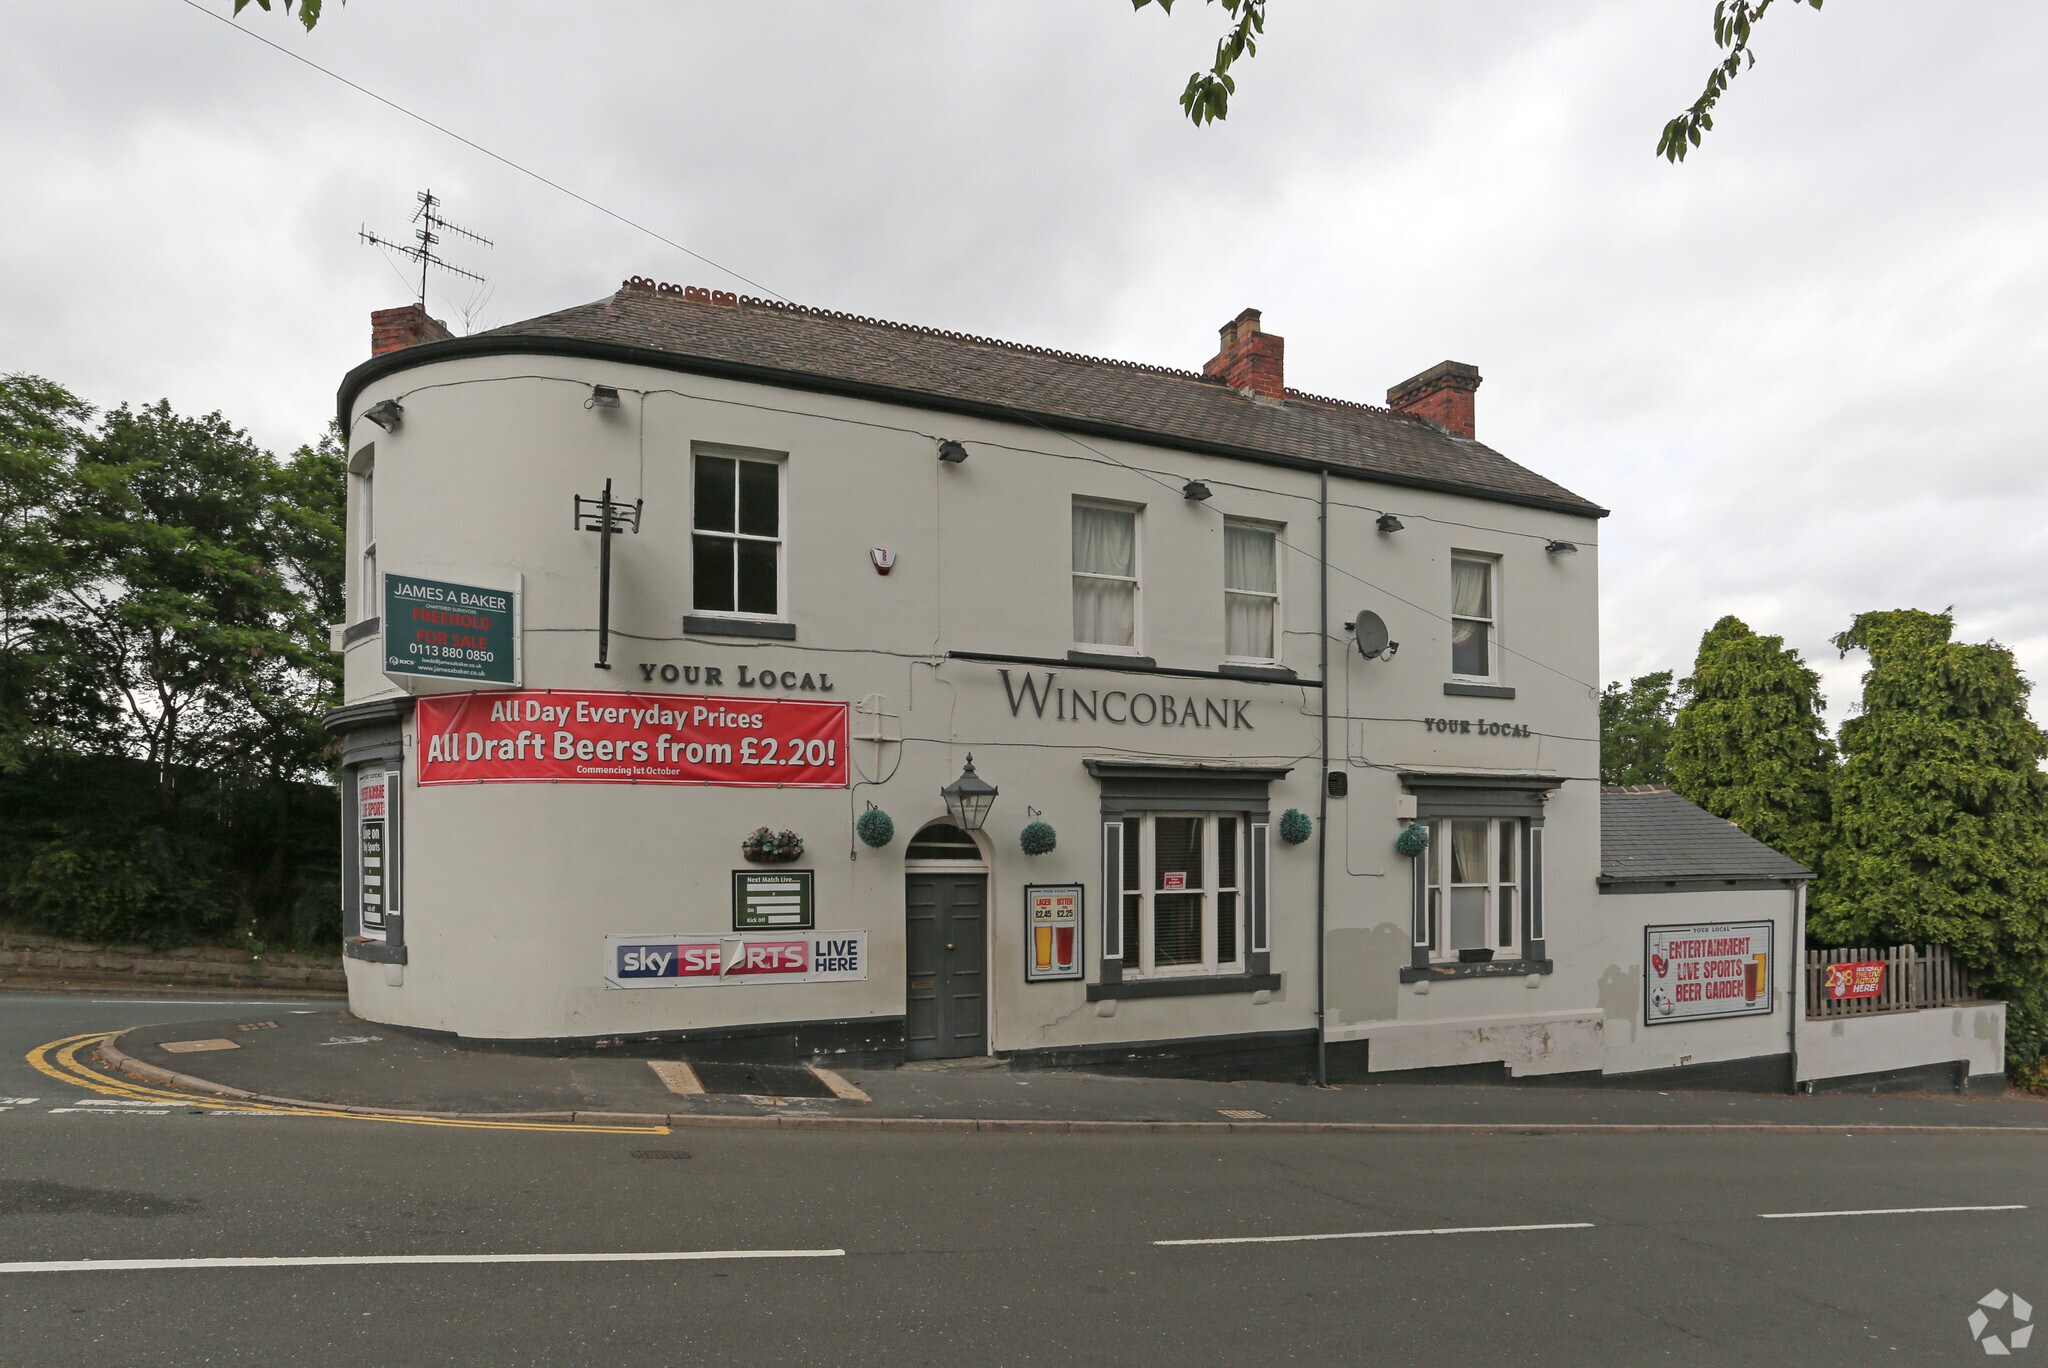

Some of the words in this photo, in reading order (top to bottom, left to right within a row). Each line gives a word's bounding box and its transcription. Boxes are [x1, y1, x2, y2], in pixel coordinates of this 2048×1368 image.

[394, 583, 443, 600] JAMES
[447, 591, 457, 603] A
[461, 592, 506, 610] BAKER
[412, 608, 492, 630] FREEHOLD
[452, 607, 477, 615] SURVEYORS
[417, 630, 448, 645] FOR
[452, 634, 488, 650] SALE
[409, 643, 438, 656] 0113
[442, 647, 463, 658] 880
[466, 650, 494, 662] 0850
[422, 657, 482, 668] leeds@jamesabaker.co.uk
[418, 665, 486, 676] www.jamesabaker.co.uk
[639, 663, 723, 686] YOUR
[737, 665, 834, 690] LOCAL
[997, 668, 1255, 731] WINCOBANK
[490, 700, 520, 722] All
[525, 700, 571, 728] Day
[576, 700, 688, 730] Everyday
[693, 705, 764, 729] Prices
[1424, 718, 1471, 734] YOUR
[1478, 719, 1531, 738] LOCAL
[427, 732, 460, 764] All
[466, 730, 546, 762] Draft
[553, 730, 649, 762] Beers
[655, 733, 732, 764] from
[740, 736, 836, 767] £2.20!
[576, 764, 632, 776] Commencing
[633, 766, 645, 774] 1st
[646, 766, 680, 776] October
[372, 828, 380, 839] on
[1036, 898, 1051, 906] LAGER
[1036, 910, 1051, 918] £2.45
[815, 940, 858, 957] LIVE
[1668, 936, 1750, 960] ENTERTAINMENT
[624, 946, 672, 976] sky
[684, 946, 804, 972] SPRTS
[815, 957, 858, 972] HERE
[1678, 962, 1700, 981] LIVE
[1704, 959, 1742, 979] SPORTS
[1676, 982, 1702, 1003] BEER
[1705, 980, 1744, 1000] GARDEN
